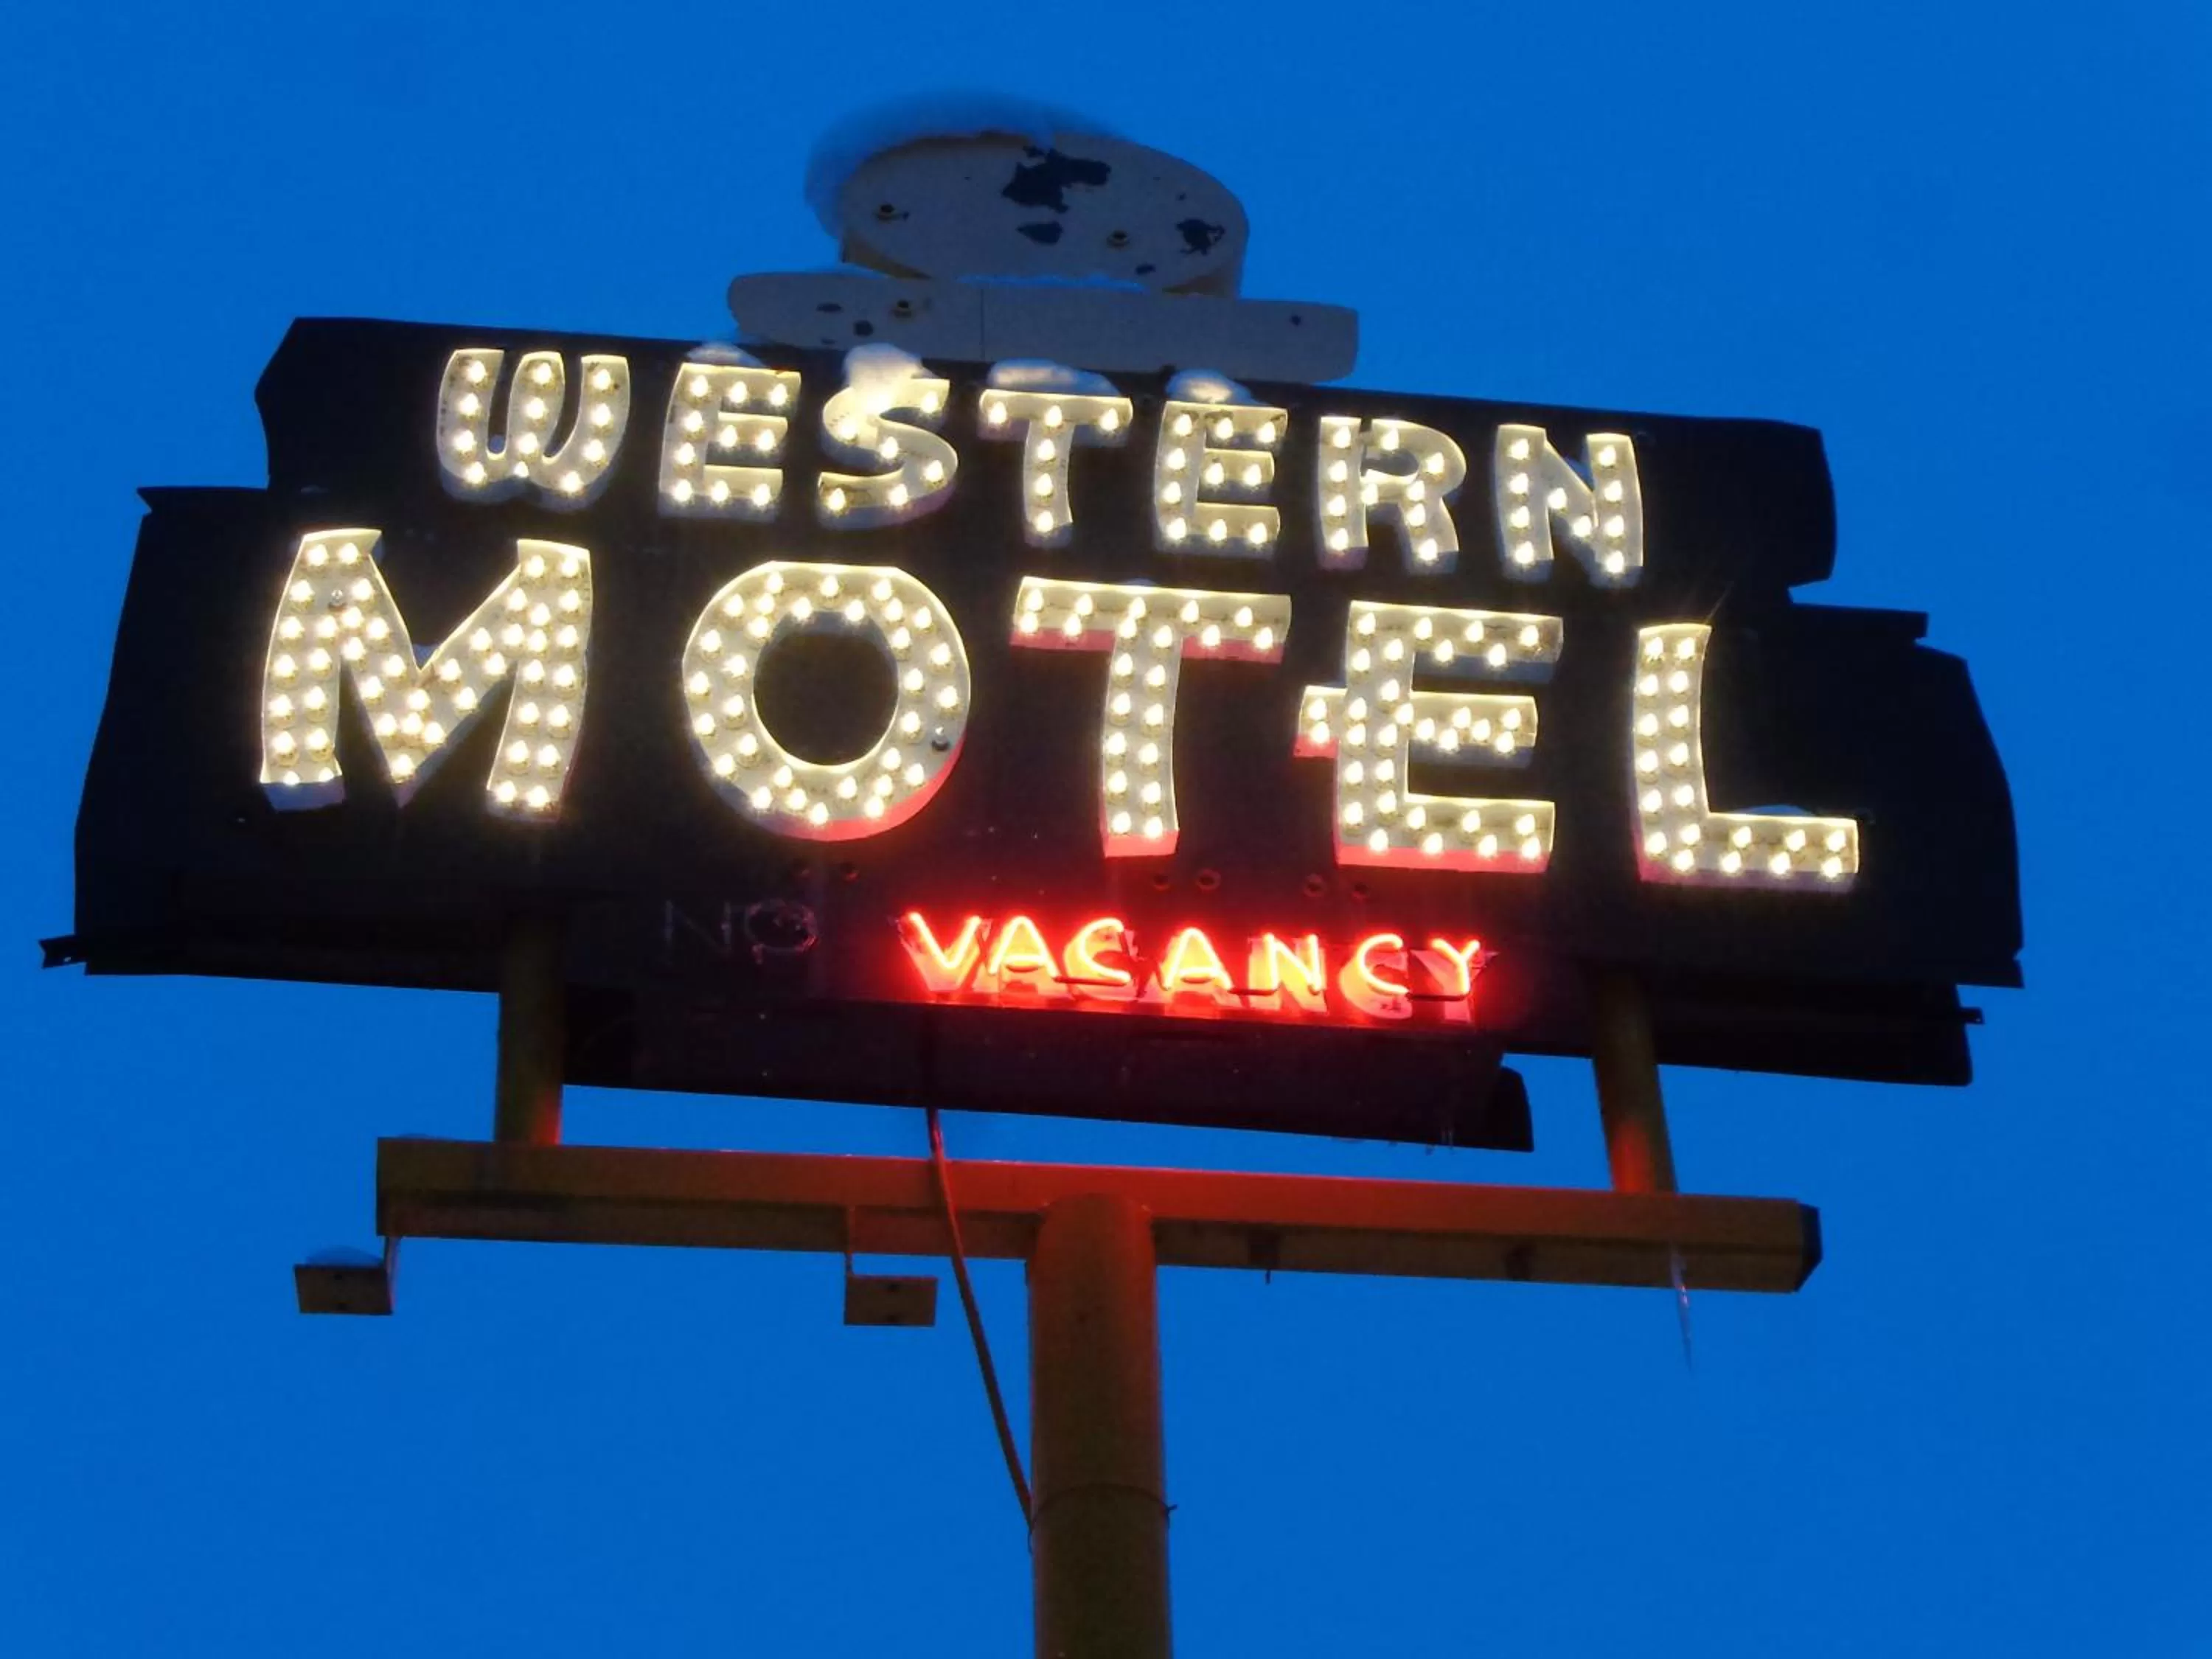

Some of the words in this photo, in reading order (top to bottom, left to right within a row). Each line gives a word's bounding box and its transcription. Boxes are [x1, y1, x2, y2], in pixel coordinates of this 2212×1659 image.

[436, 347, 1644, 585] WESTERN
[258, 528, 1860, 885] MOTEL
[663, 898, 818, 960] NO
[901, 909, 1493, 1020] VACANCY
